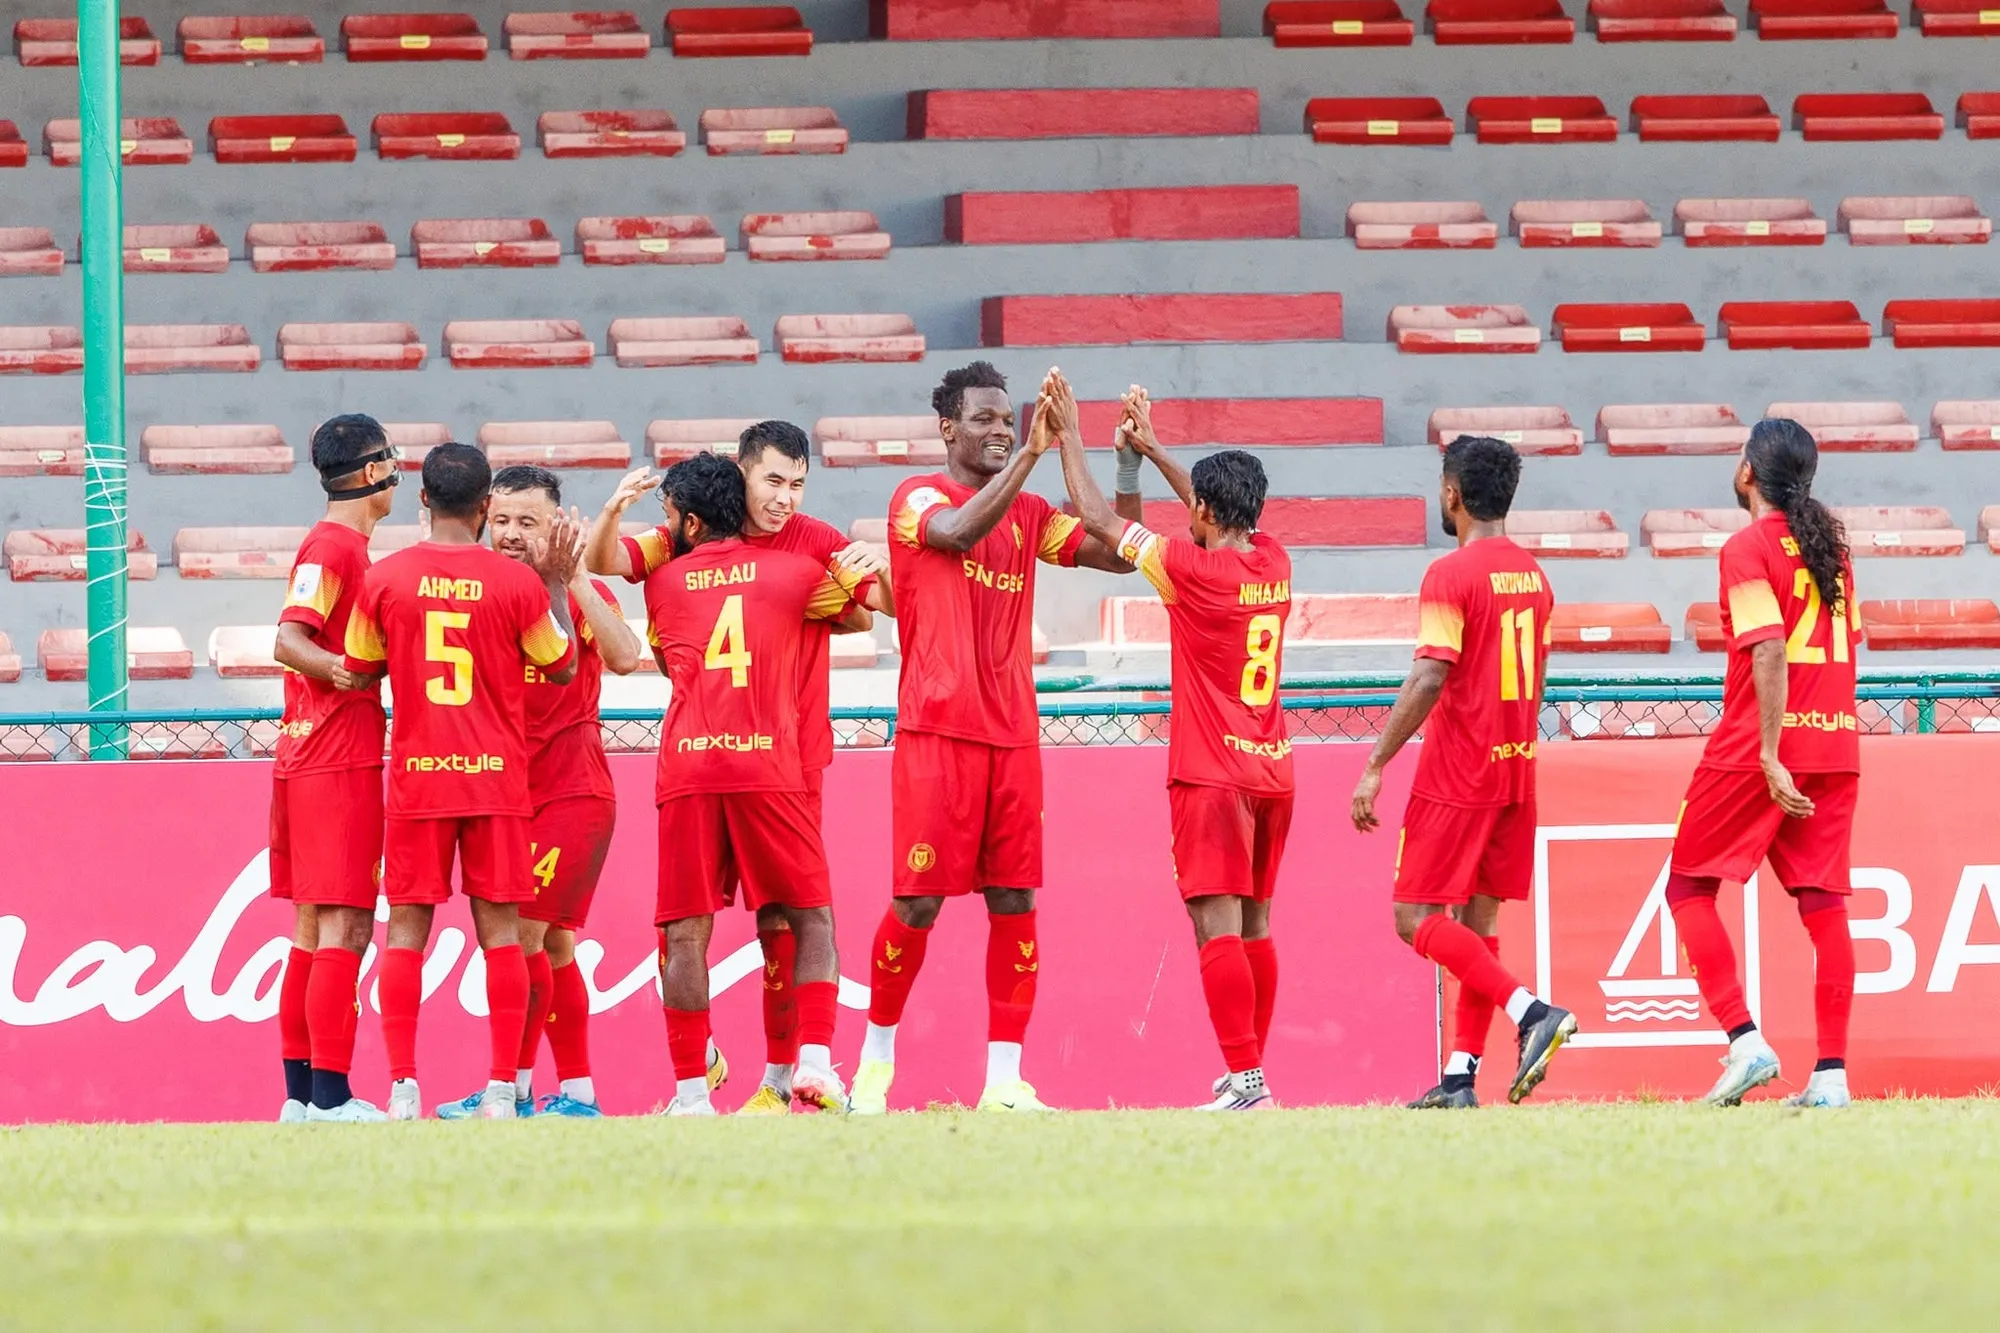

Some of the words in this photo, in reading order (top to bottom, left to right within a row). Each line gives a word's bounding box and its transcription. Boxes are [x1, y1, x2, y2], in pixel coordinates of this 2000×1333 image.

[417, 576, 483, 601] AHMED
[685, 562, 757, 591] SIFAAU
[1239, 580, 1290, 605] NIHAAN
[1786, 568, 1849, 664] 21
[704, 595, 752, 688] 4
[1500, 607, 1535, 700] 11
[425, 611, 474, 706] 5
[1239, 613, 1281, 706] 8
[1782, 711, 1856, 731] extyle
[677, 732, 773, 753] nextyle
[405, 753, 504, 774] nextyle
